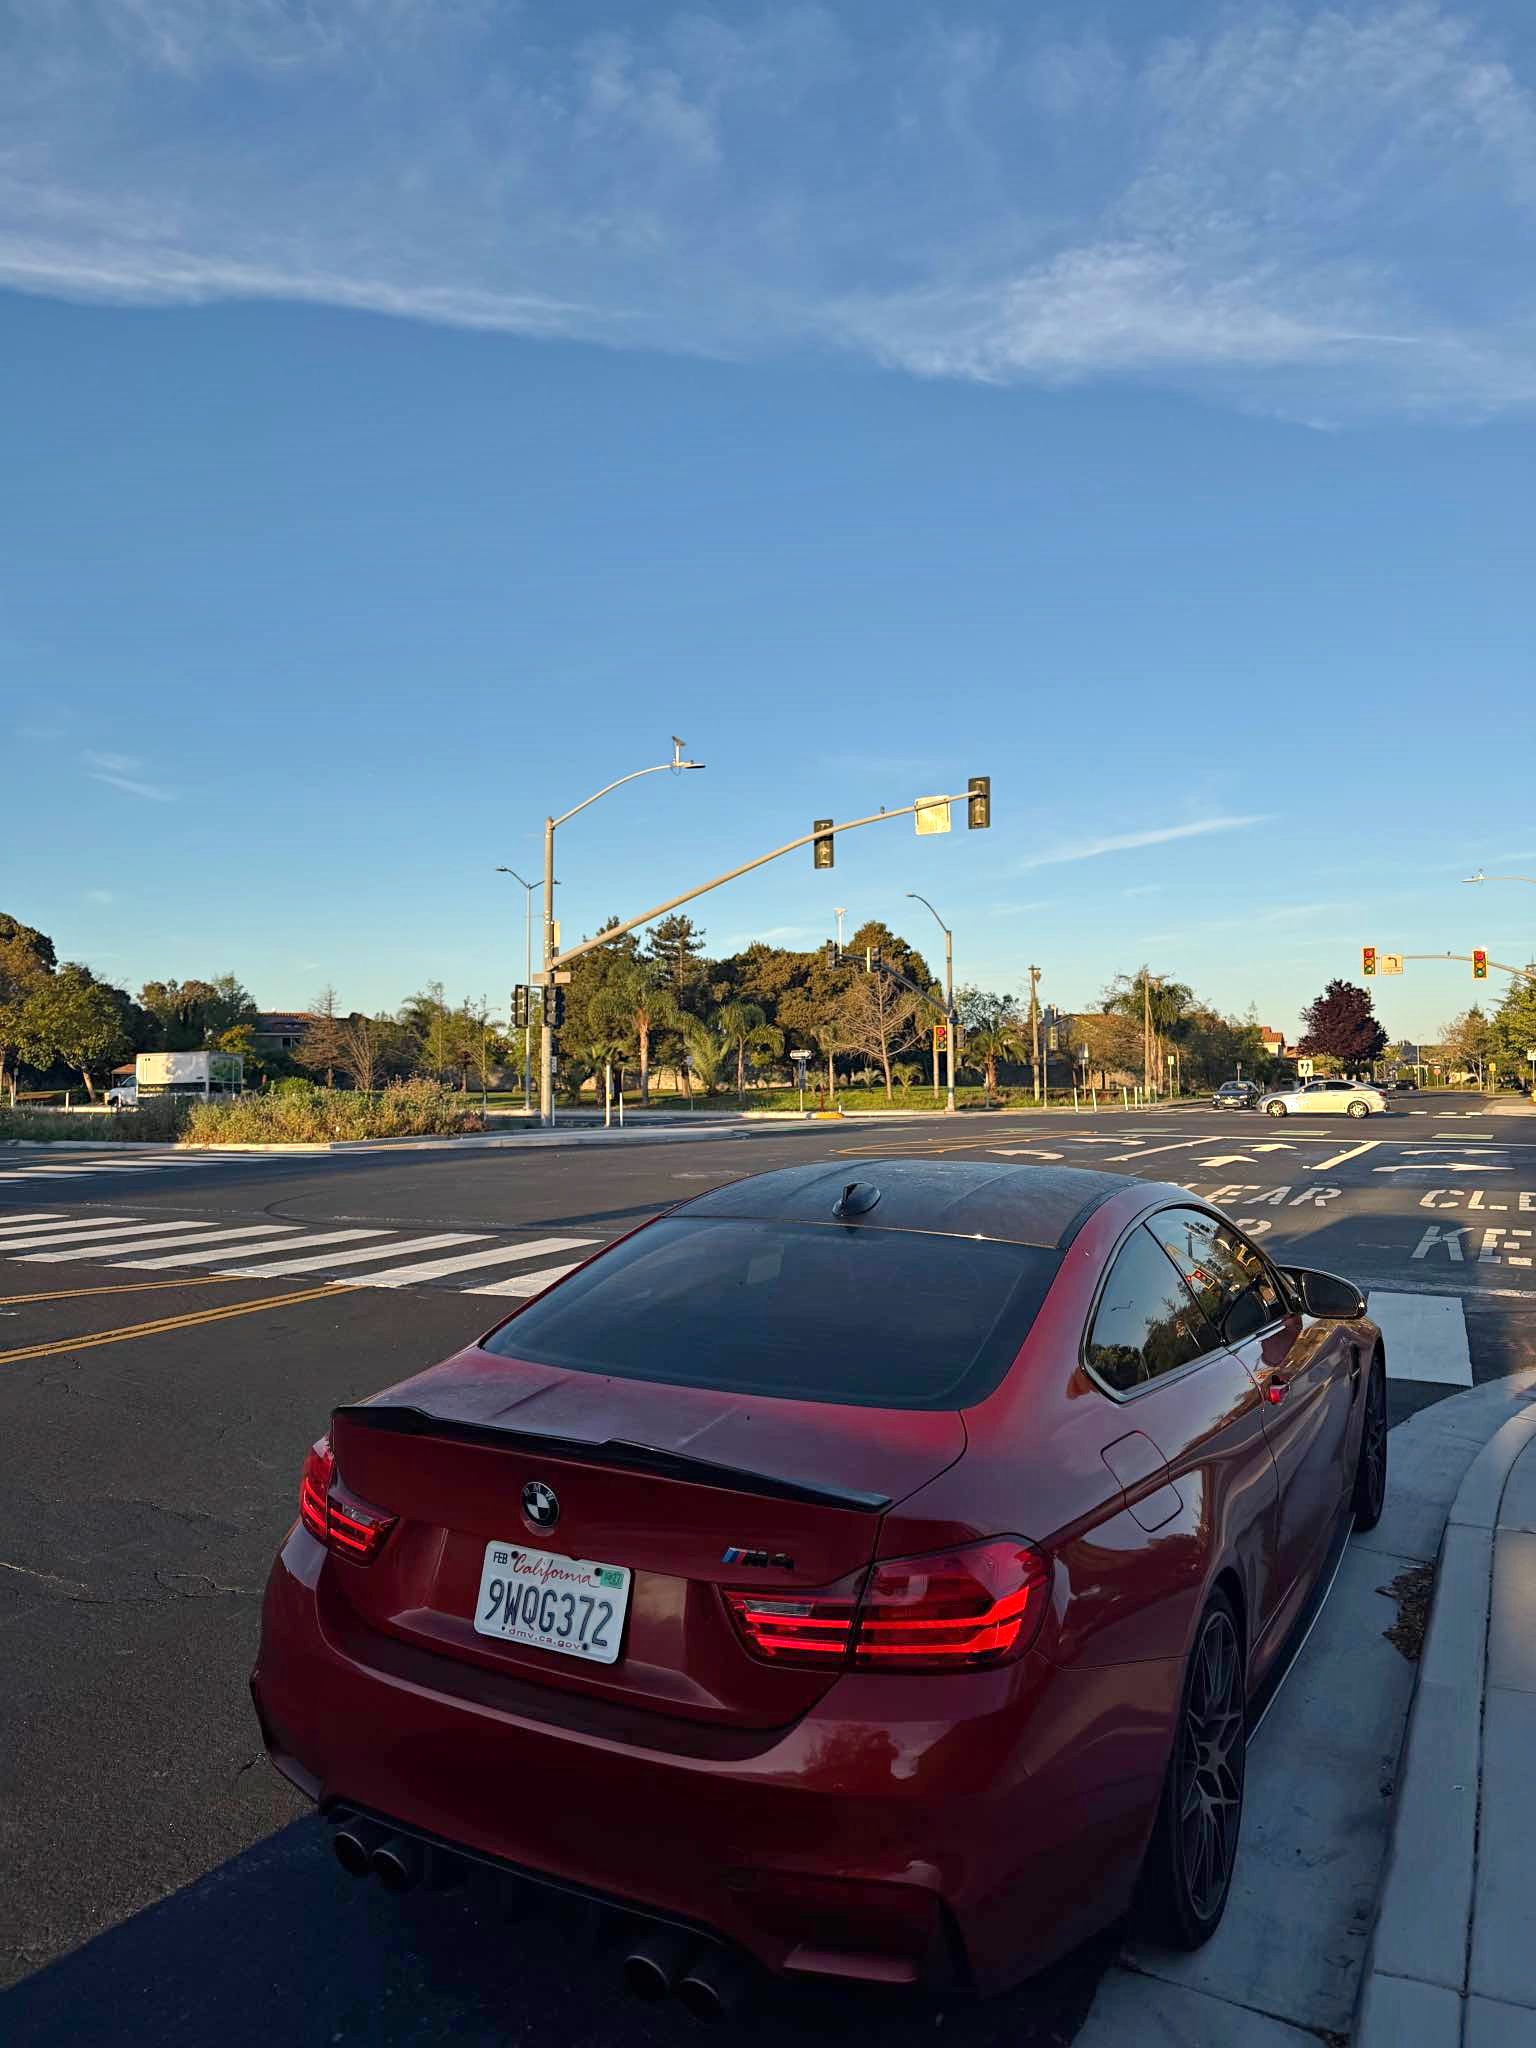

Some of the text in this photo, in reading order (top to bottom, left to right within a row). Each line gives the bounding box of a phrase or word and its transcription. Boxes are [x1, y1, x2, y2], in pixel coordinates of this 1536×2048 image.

[493, 1551, 508, 1565] FEB
[512, 1553, 600, 1588] California
[484, 1578, 614, 1647] 9WQG372
[509, 1627, 582, 1650] dmv.ca.gov
